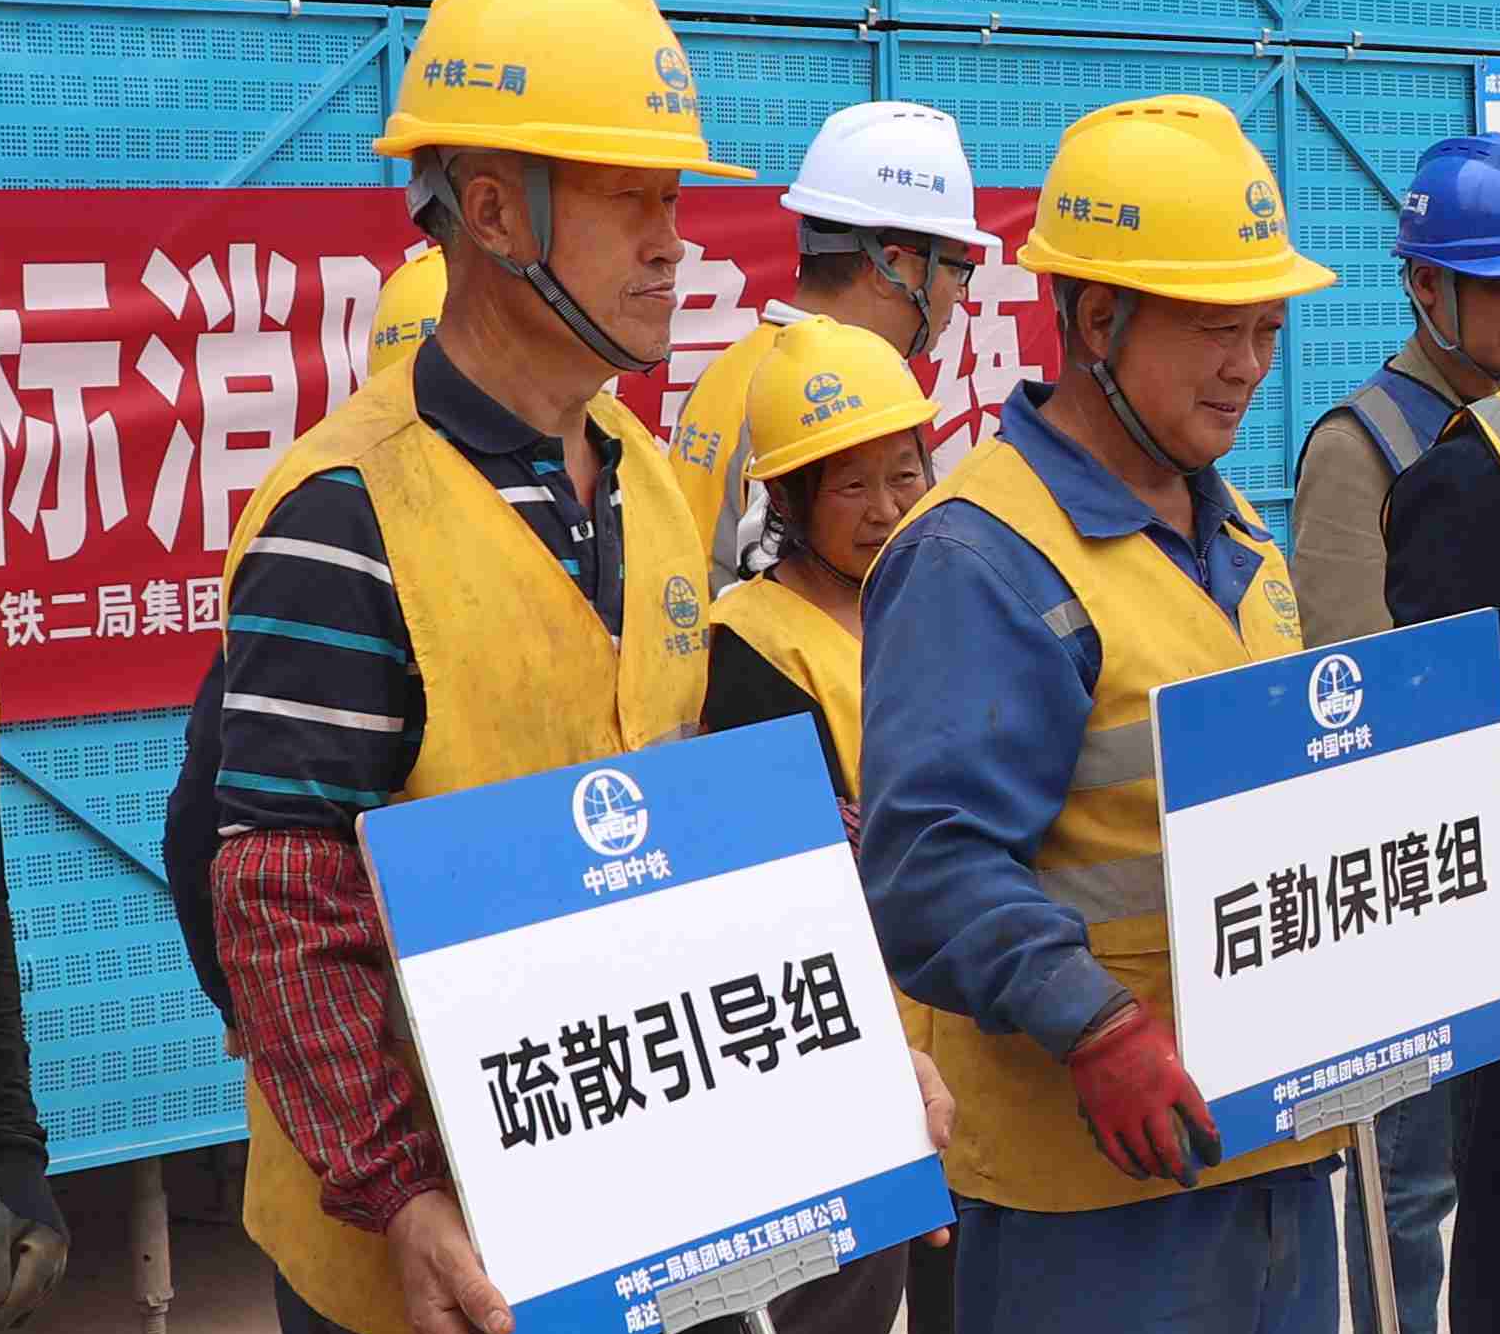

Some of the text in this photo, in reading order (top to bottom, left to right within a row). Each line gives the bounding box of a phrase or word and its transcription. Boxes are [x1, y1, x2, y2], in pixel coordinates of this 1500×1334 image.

[424, 59, 528, 96] 中铁二局
[877, 165, 946, 195] 中铁二局
[1057, 192, 1140, 231] 中铁二局
[801, 394, 863, 427] 中国中铁
[1307, 724, 1372, 762] 中国中铁
[582, 850, 672, 896] 中国中铁
[1212, 816, 1488, 980] 后勤保障组
[480, 952, 861, 1150] 疏散引导组
[1273, 1025, 1452, 1105] 中铁二局集团电务工程有限公司
[614, 1197, 848, 1300] 中铁二局集团电务工程有限公司
